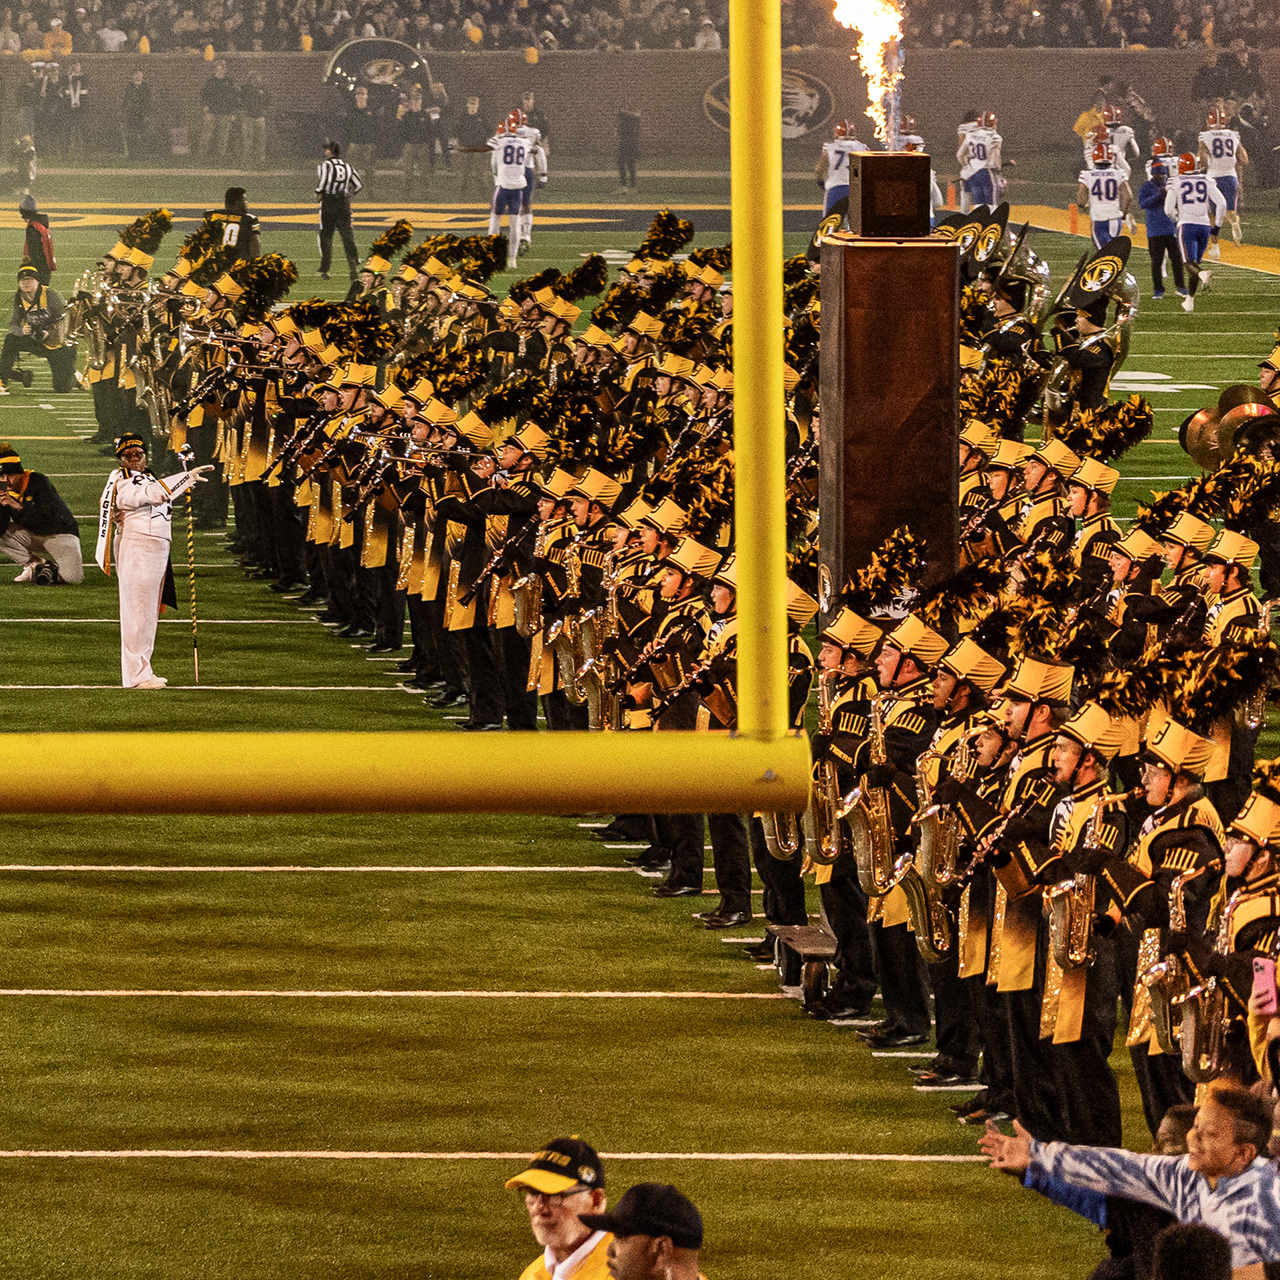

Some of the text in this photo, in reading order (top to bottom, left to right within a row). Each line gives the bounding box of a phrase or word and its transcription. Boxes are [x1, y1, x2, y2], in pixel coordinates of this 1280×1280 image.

[503, 144, 525, 166] 88
[1212, 138, 1234, 158] 89
[1092, 178, 1118, 201] 40
[1181, 181, 1207, 204] 29
[100, 481, 114, 538] TIGERS
